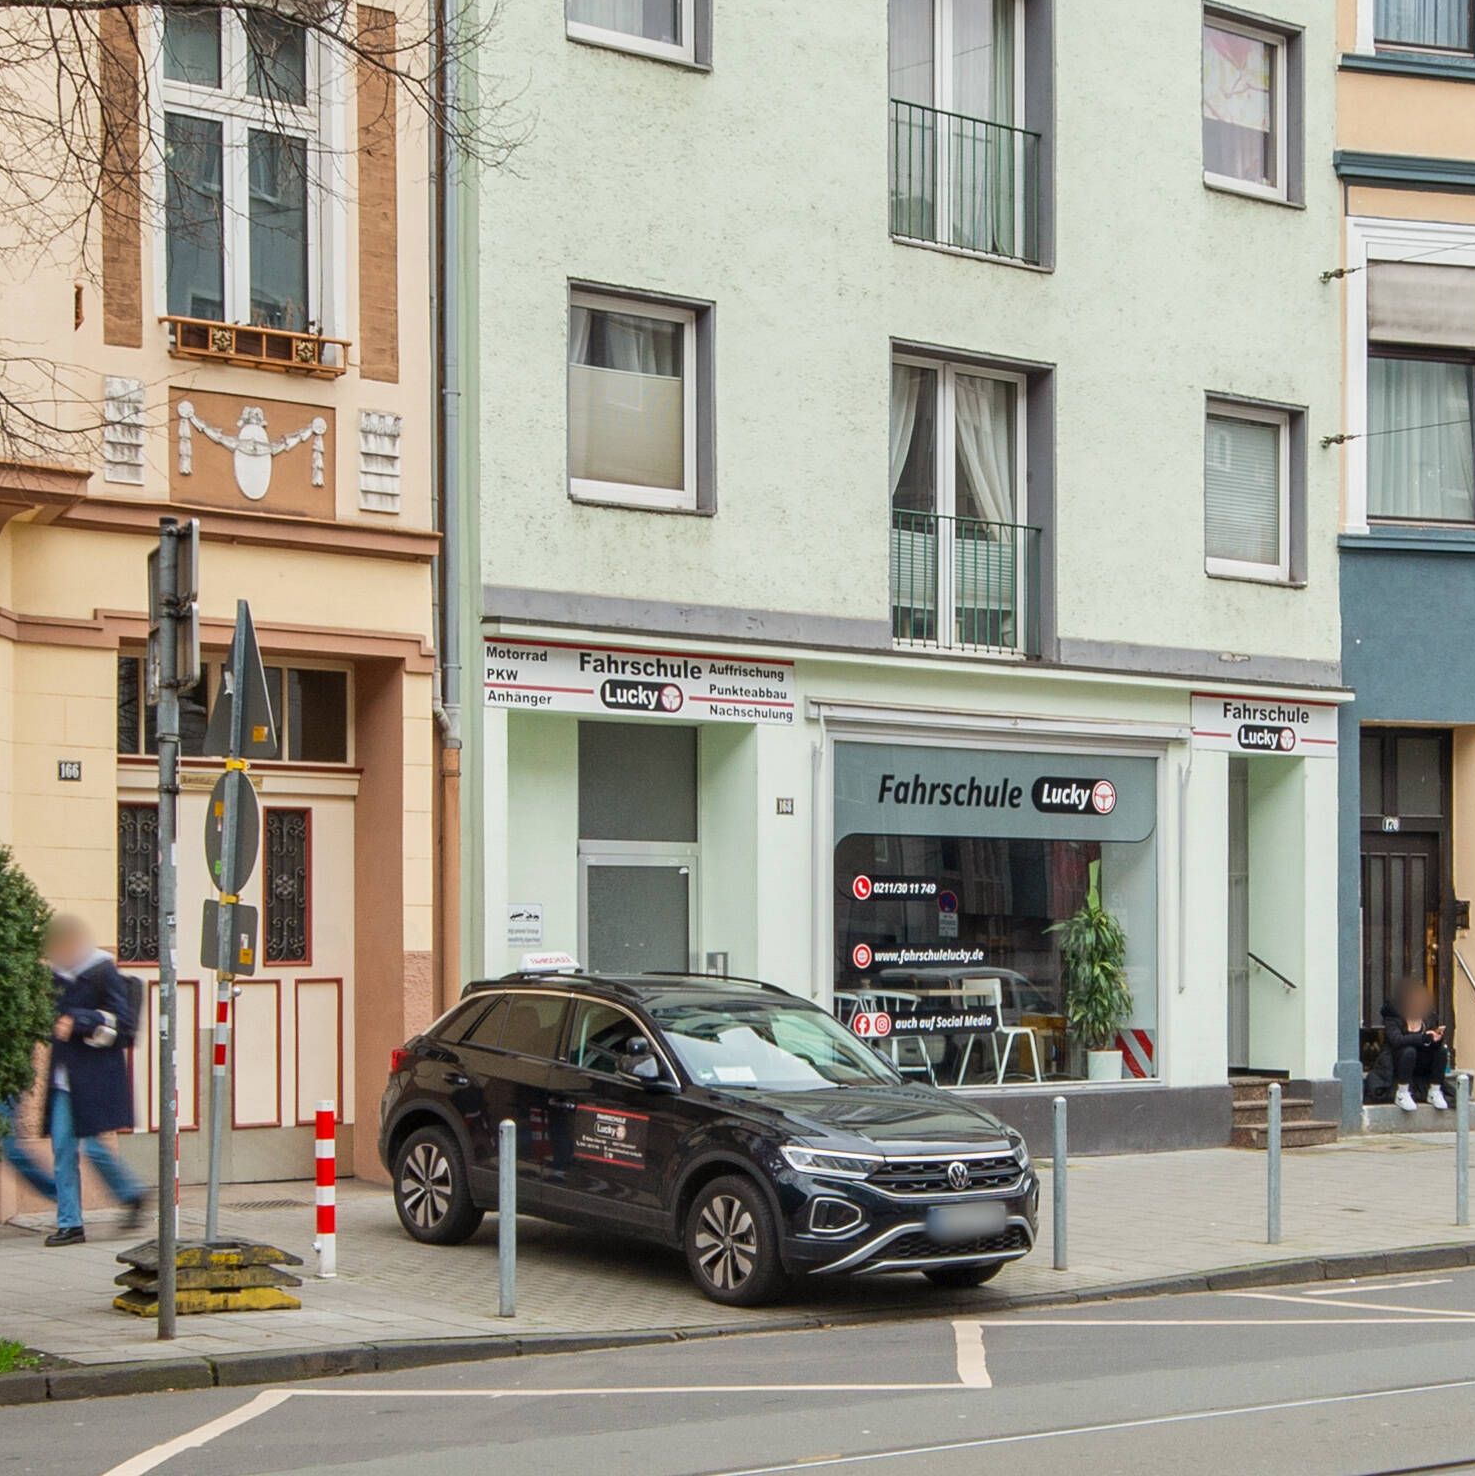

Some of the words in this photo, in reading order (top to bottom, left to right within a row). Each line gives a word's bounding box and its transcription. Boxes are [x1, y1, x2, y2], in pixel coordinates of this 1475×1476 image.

[486, 646, 548, 663] Motorrad
[579, 652, 703, 680] Fahrschule
[709, 663, 785, 682] Auffrischung
[487, 668, 519, 682] PKW
[487, 690, 552, 706] Anhänger
[605, 683, 659, 710] Lucky
[709, 684, 787, 700] Punkteabbau
[709, 704, 794, 723] Nachschulung
[1223, 702, 1310, 724] Fahrschule
[1240, 728, 1279, 750] Lucky
[61, 763, 80, 779] 166
[878, 774, 1023, 809] Fahrschule
[1041, 782, 1091, 811] Lucky
[873, 882, 907, 894] 0211/30
[909, 883, 920, 894] 11
[921, 883, 937, 895] 749
[874, 948, 984, 965] www.fahrschulelucky.de
[895, 1017, 917, 1029] auch
[919, 1016, 935, 1031] auf
[936, 1016, 963, 1029] Social
[964, 1015, 992, 1027] Media
